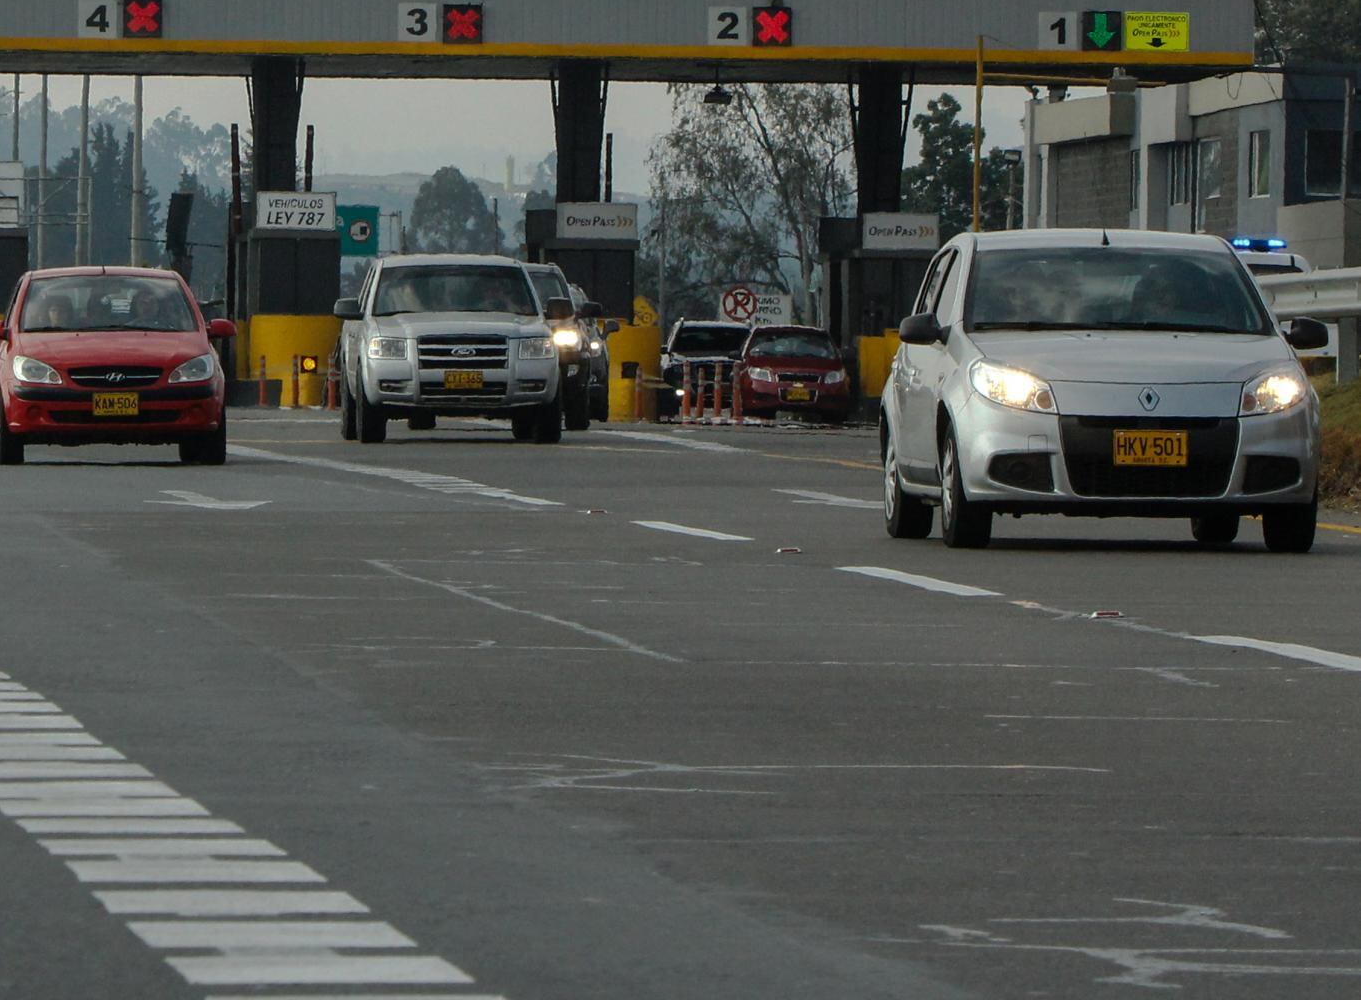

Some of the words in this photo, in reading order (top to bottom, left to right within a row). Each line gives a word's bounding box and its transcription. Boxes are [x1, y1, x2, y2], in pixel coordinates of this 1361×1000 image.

[85, 5, 110, 32] 4
[406, 9, 428, 35] 3
[716, 12, 740, 39] 2
[1050, 17, 1066, 45] 1
[268, 199, 323, 209] VEHICULOS
[266, 211, 295, 225] LEY
[297, 211, 326, 226] 787
[1116, 436, 1147, 456] HKV
[1153, 437, 1184, 457] 501
